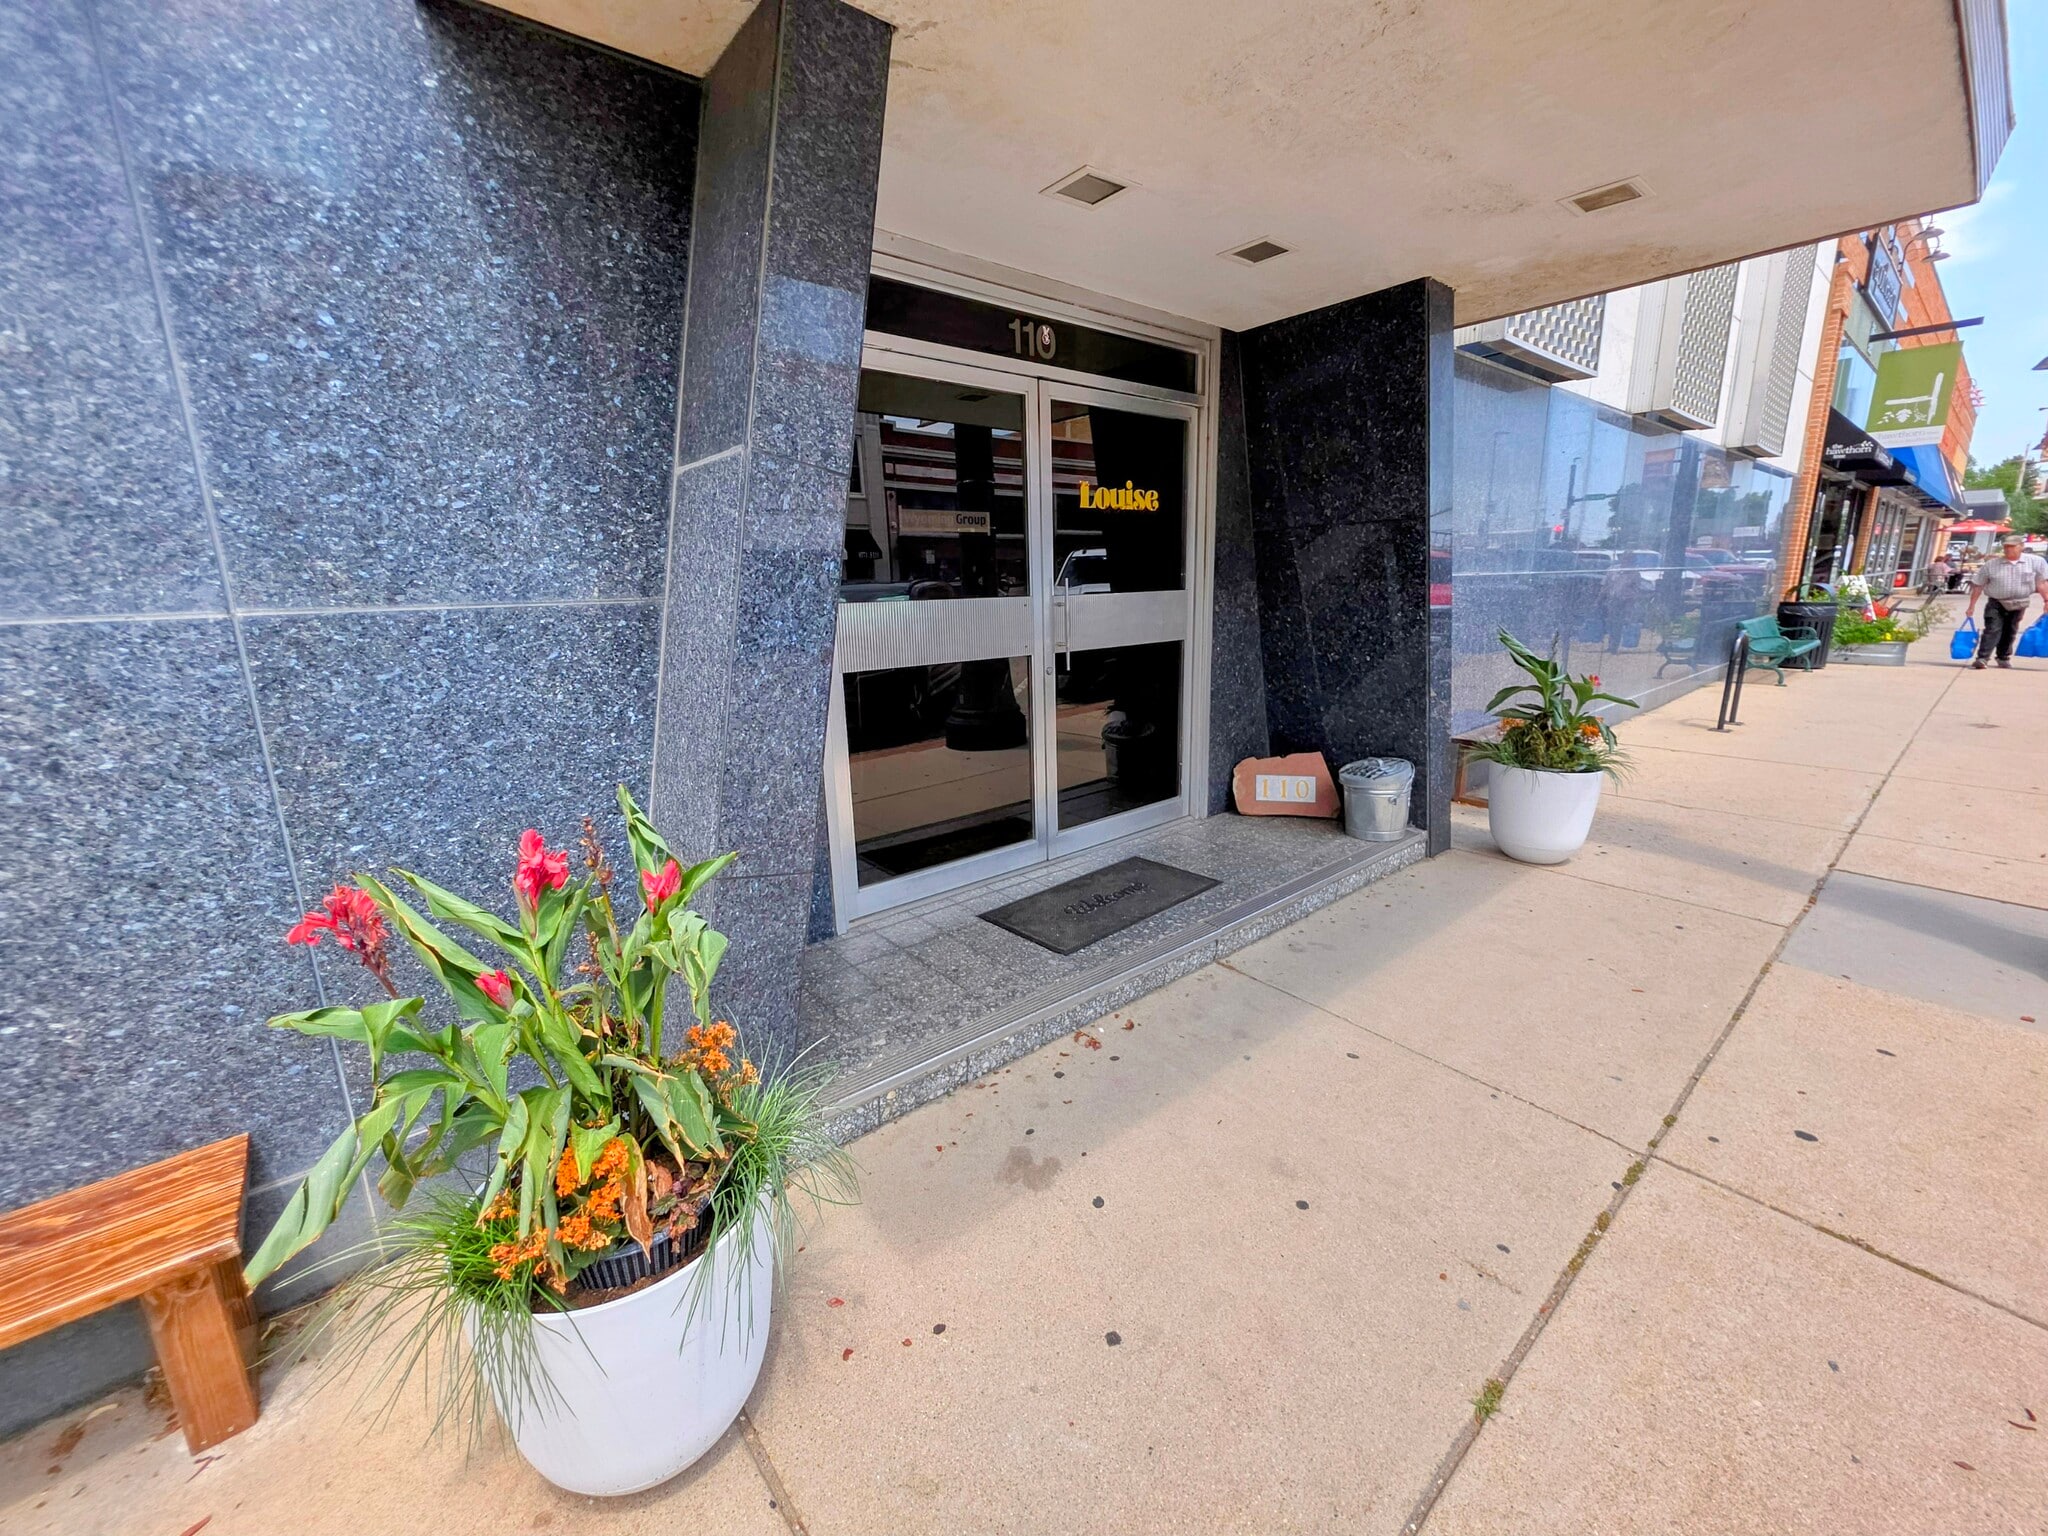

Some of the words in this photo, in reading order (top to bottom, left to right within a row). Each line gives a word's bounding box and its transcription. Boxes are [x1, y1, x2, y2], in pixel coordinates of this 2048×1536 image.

[1008, 318, 1056, 360] 110
[1825, 446, 1872, 455] hawthorn
[1079, 479, 1159, 512] Louise
[955, 513, 986, 527] Group
[1262, 778, 1310, 799] 110
[1063, 882, 1150, 914] Welcome
